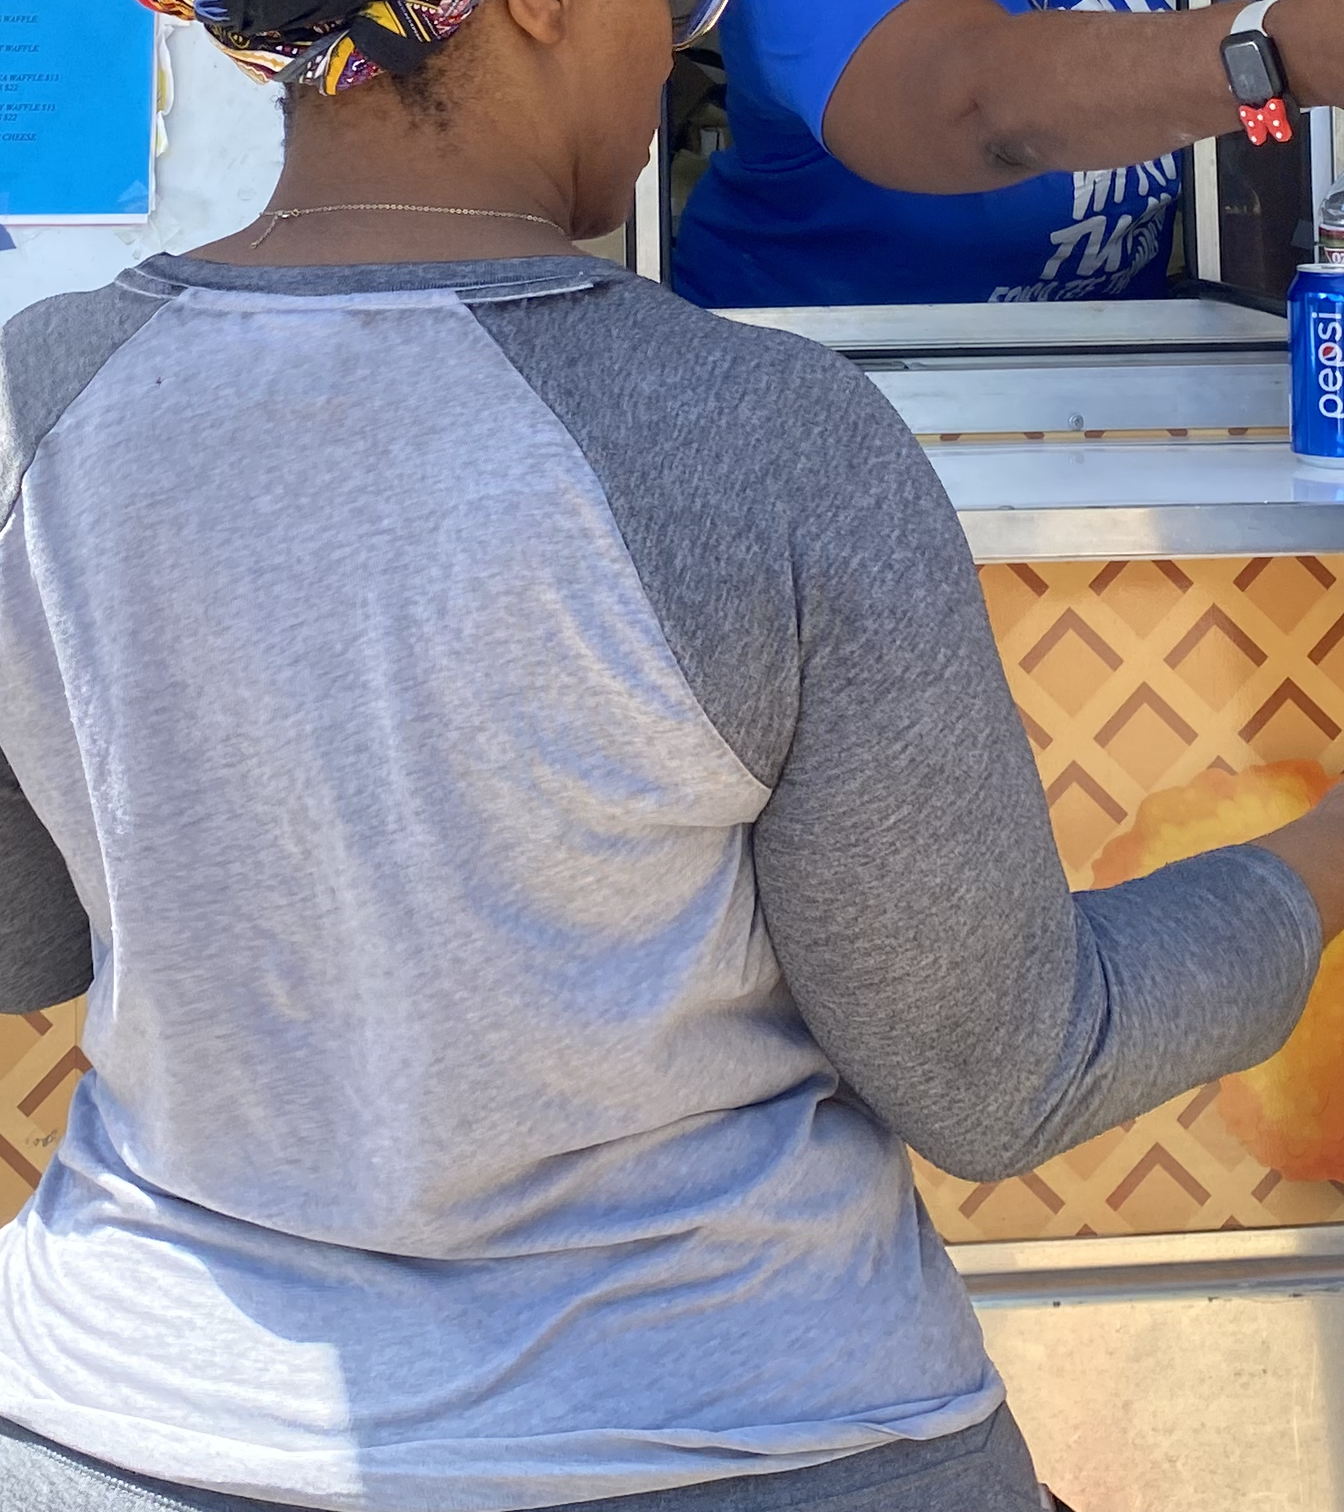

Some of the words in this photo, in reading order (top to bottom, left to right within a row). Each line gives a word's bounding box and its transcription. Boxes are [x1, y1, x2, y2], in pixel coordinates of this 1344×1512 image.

[3, 14, 38, 24] WAFFLE
[6, 44, 40, 53] WAFFLE
[9, 73, 45, 82] WAFFLE
[6, 103, 41, 112] WAFFLE
[0, 133, 38, 142] CHEESE
